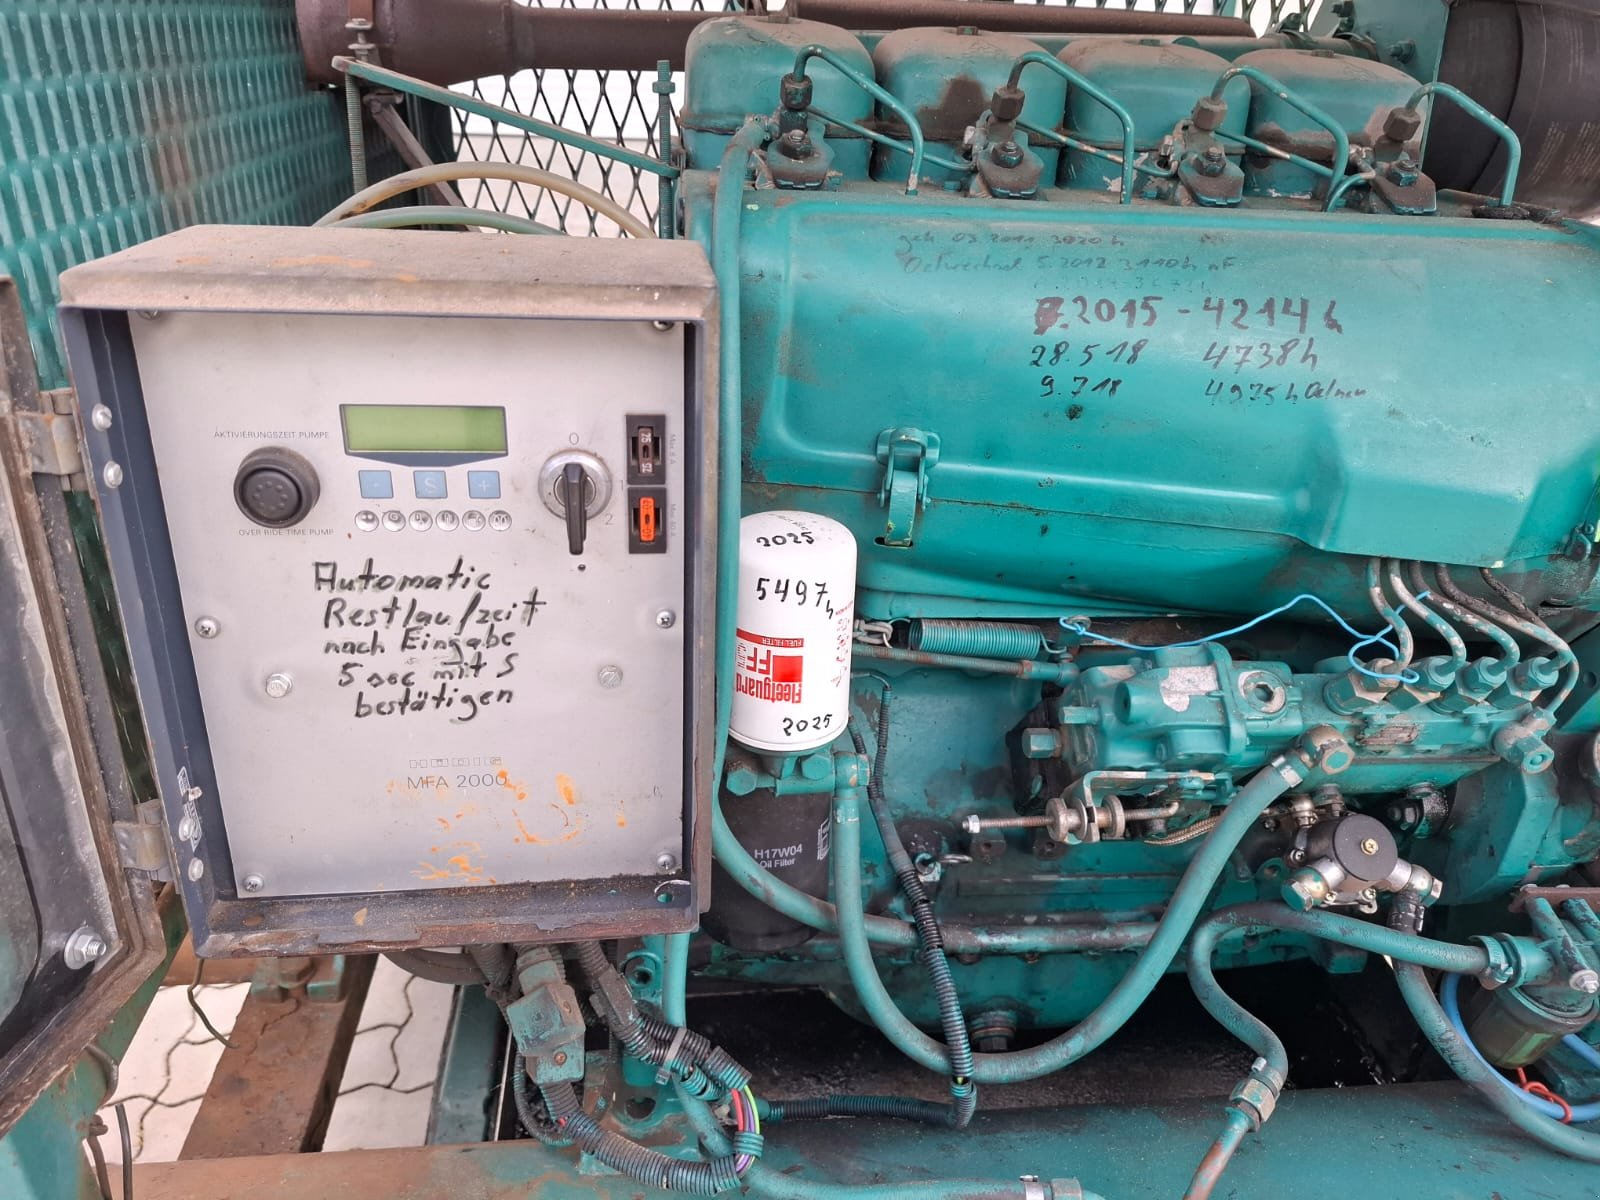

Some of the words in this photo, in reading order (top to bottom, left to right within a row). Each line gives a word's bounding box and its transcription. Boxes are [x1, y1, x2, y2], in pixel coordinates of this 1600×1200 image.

[1202, 296, 1310, 334] 4214
[213, 431, 297, 439] AKTIVIERUNGSZEIT
[298, 431, 329, 439] PUMPE
[238, 528, 262, 536] OVER
[756, 531, 815, 547] 2025
[312, 555, 491, 593] Automatic
[324, 630, 385, 656] nach
[401, 623, 516, 666] Eingabe
[338, 662, 364, 687] 5
[432, 651, 487, 681] mit
[736, 672, 802, 704] Fleetguard
[354, 682, 514, 722] bestätigen
[782, 713, 833, 736] 2025
[407, 775, 449, 790] MFA
[456, 772, 507, 788] 2000
[754, 843, 803, 859] H17W04
[759, 860, 772, 869] Oil
[774, 858, 796, 868] Filter
